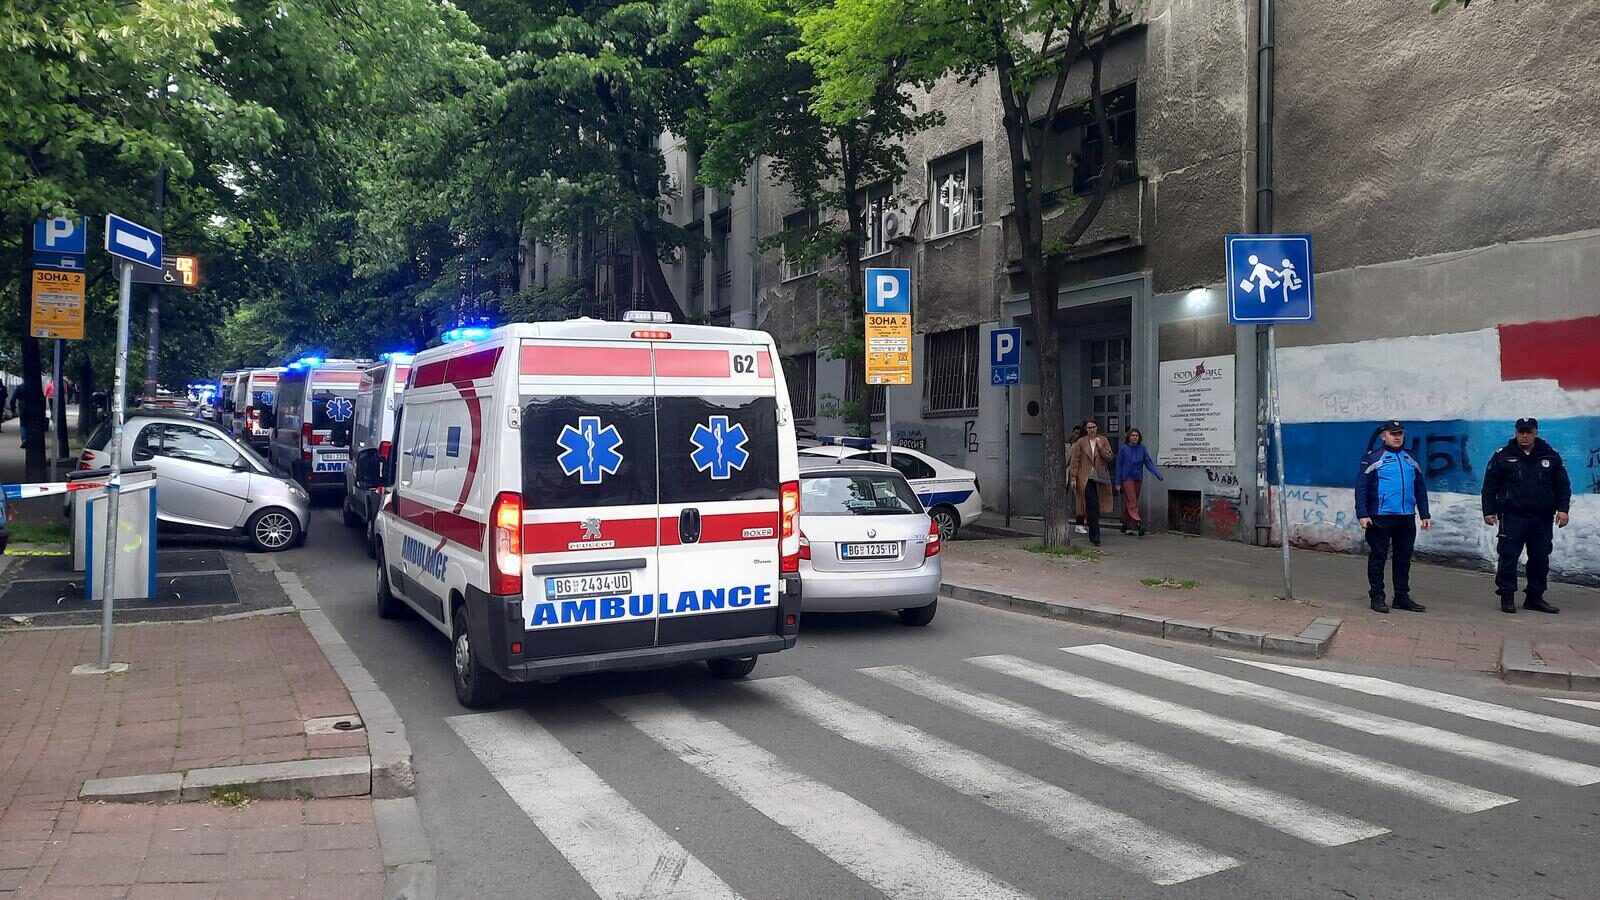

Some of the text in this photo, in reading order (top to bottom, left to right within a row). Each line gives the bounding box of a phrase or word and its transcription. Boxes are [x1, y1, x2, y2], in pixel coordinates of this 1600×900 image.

[45, 217, 74, 247] P
[37, 272, 81, 283] ЗОНА 2
[876, 275, 899, 307] P
[869, 316, 907, 325] ЗОНА 2
[996, 333, 1014, 362] P
[733, 353, 755, 374] 62
[743, 529, 772, 537] BOXER
[569, 541, 613, 549] PEUGEOT
[848, 544, 860, 555] BG
[401, 535, 449, 583] AMBULANCE
[556, 579, 572, 594] BG
[530, 583, 772, 626] AMBULANCE
